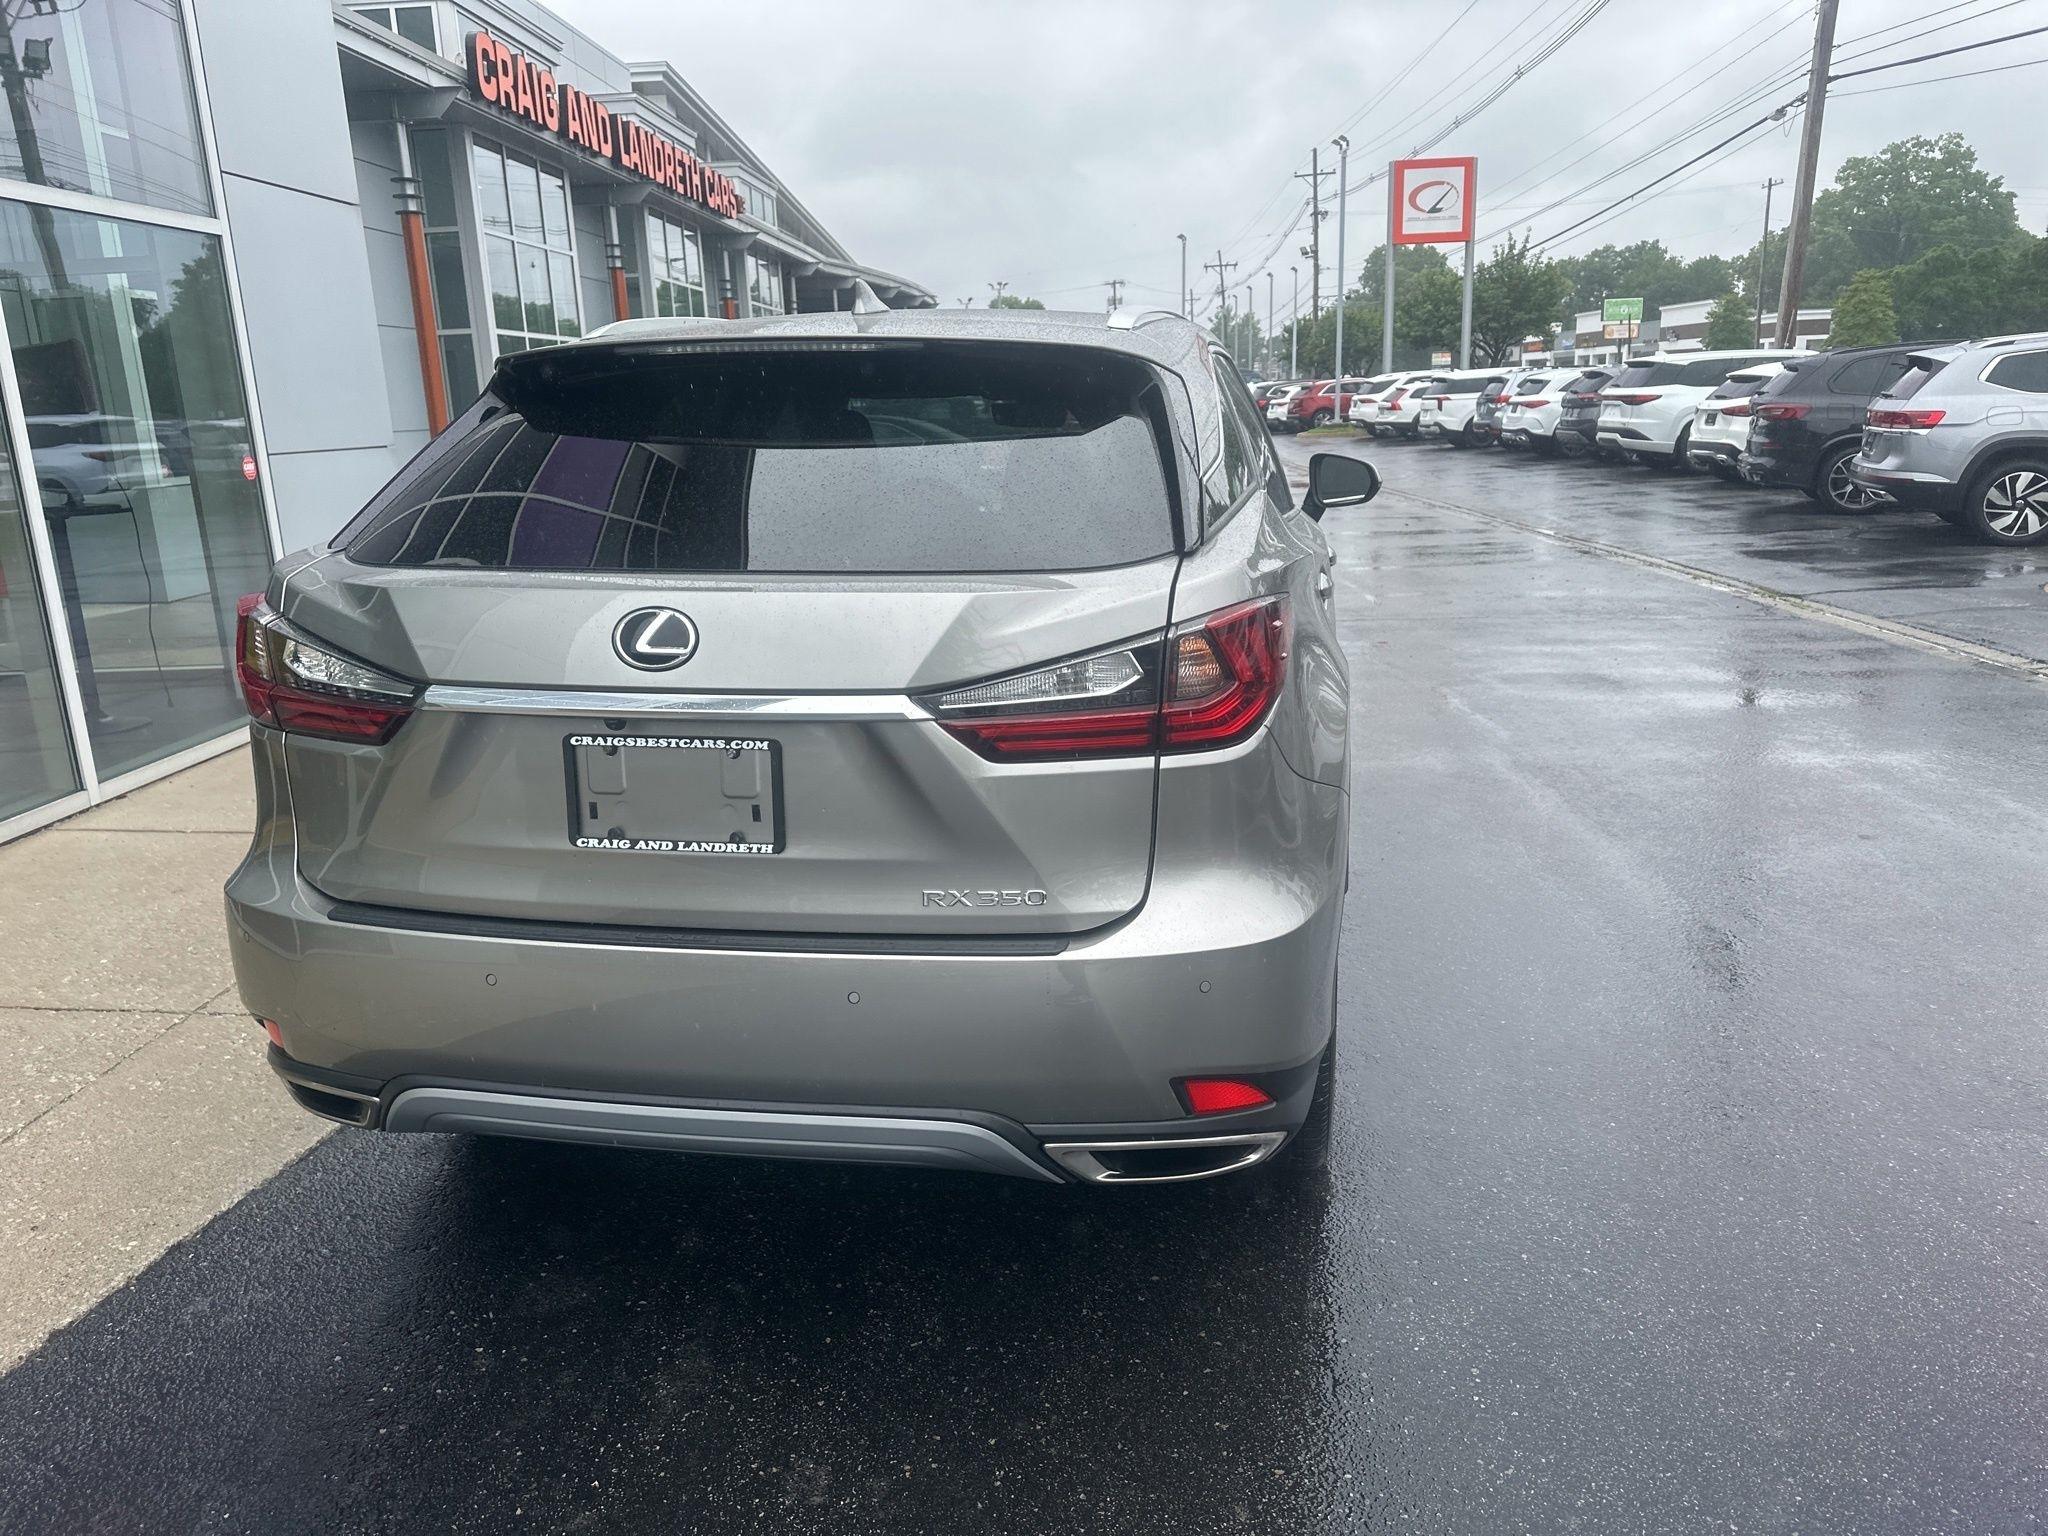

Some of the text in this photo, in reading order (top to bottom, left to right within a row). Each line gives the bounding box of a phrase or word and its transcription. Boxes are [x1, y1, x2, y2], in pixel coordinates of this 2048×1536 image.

[475, 31, 738, 220] CRAIG AND LANDRETH CARS
[570, 736, 769, 751] CRAIGSBESTCARS.COM
[576, 837, 775, 855] CRAIG AND LANDRETH
